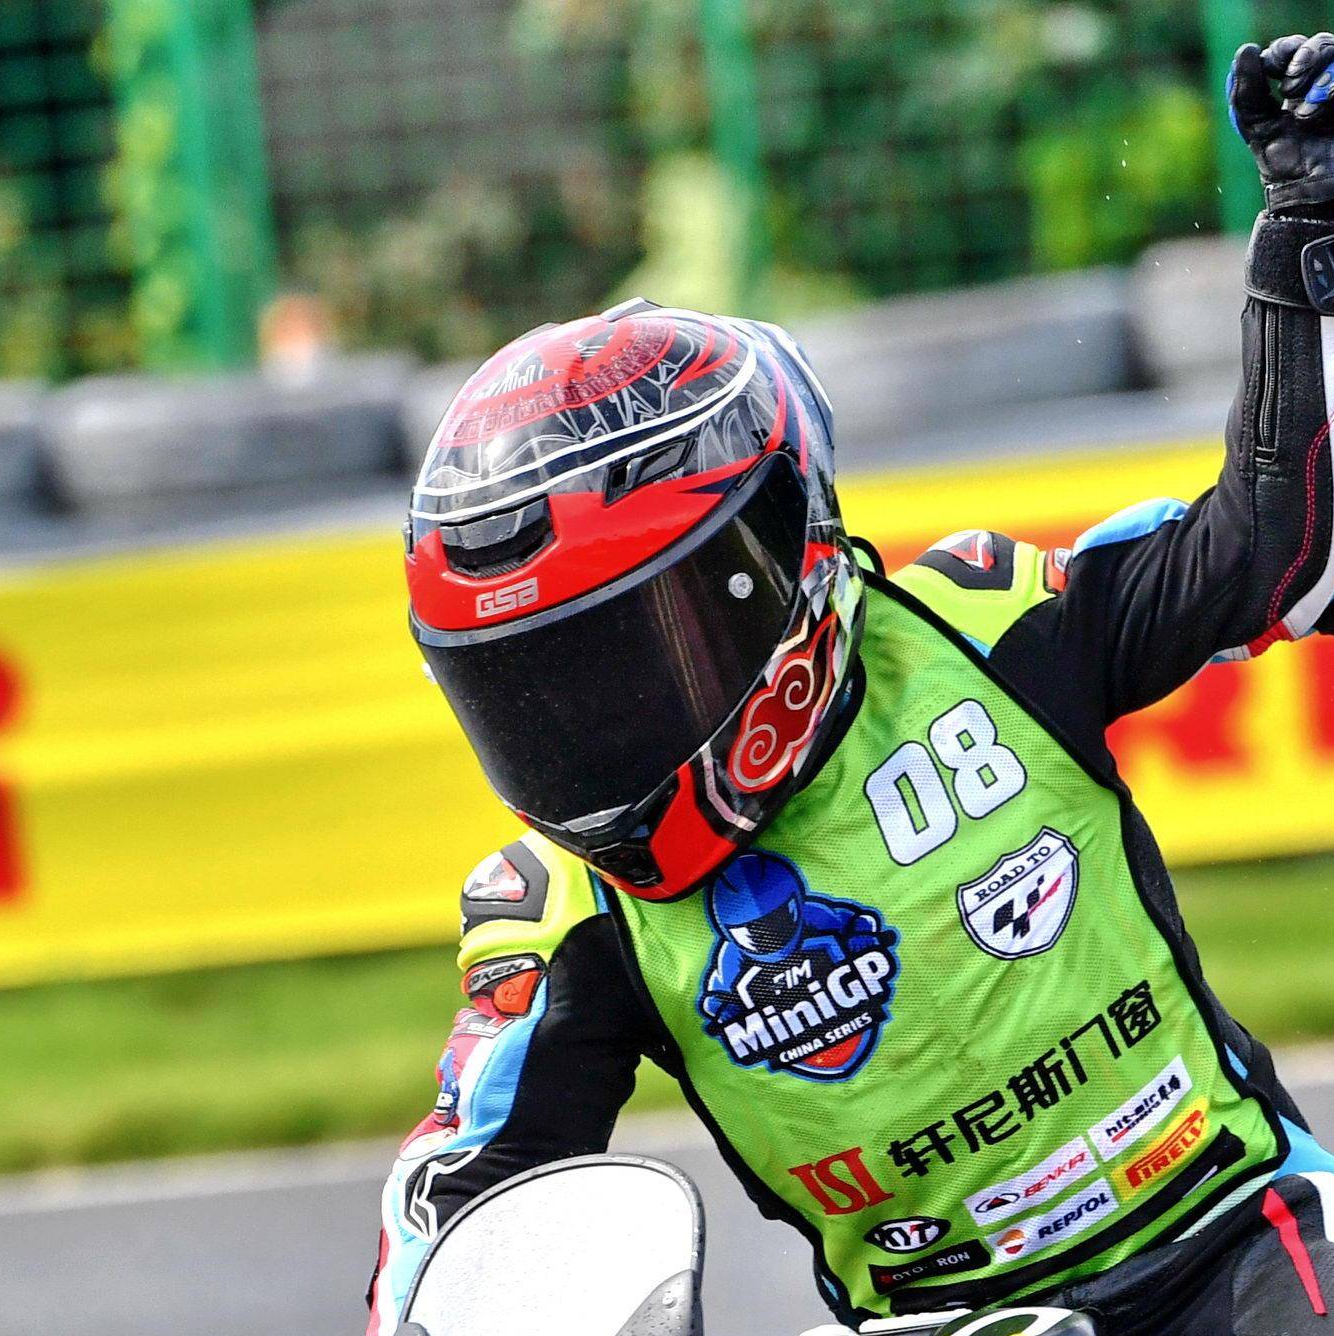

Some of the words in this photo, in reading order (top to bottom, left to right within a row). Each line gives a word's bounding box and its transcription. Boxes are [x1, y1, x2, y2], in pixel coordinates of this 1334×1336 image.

[475, 576, 539, 619] GSB
[862, 697, 1028, 867] 08
[974, 864, 1026, 902] ROAD
[1026, 846, 1052, 864] TO
[723, 951, 890, 1059] MiniGP
[778, 1038, 825, 1063] CHINA
[825, 1011, 873, 1044] SERIES
[887, 979, 1162, 1178] 轩尼斯门窗
[1037, 1192, 1110, 1240] REPSOL
